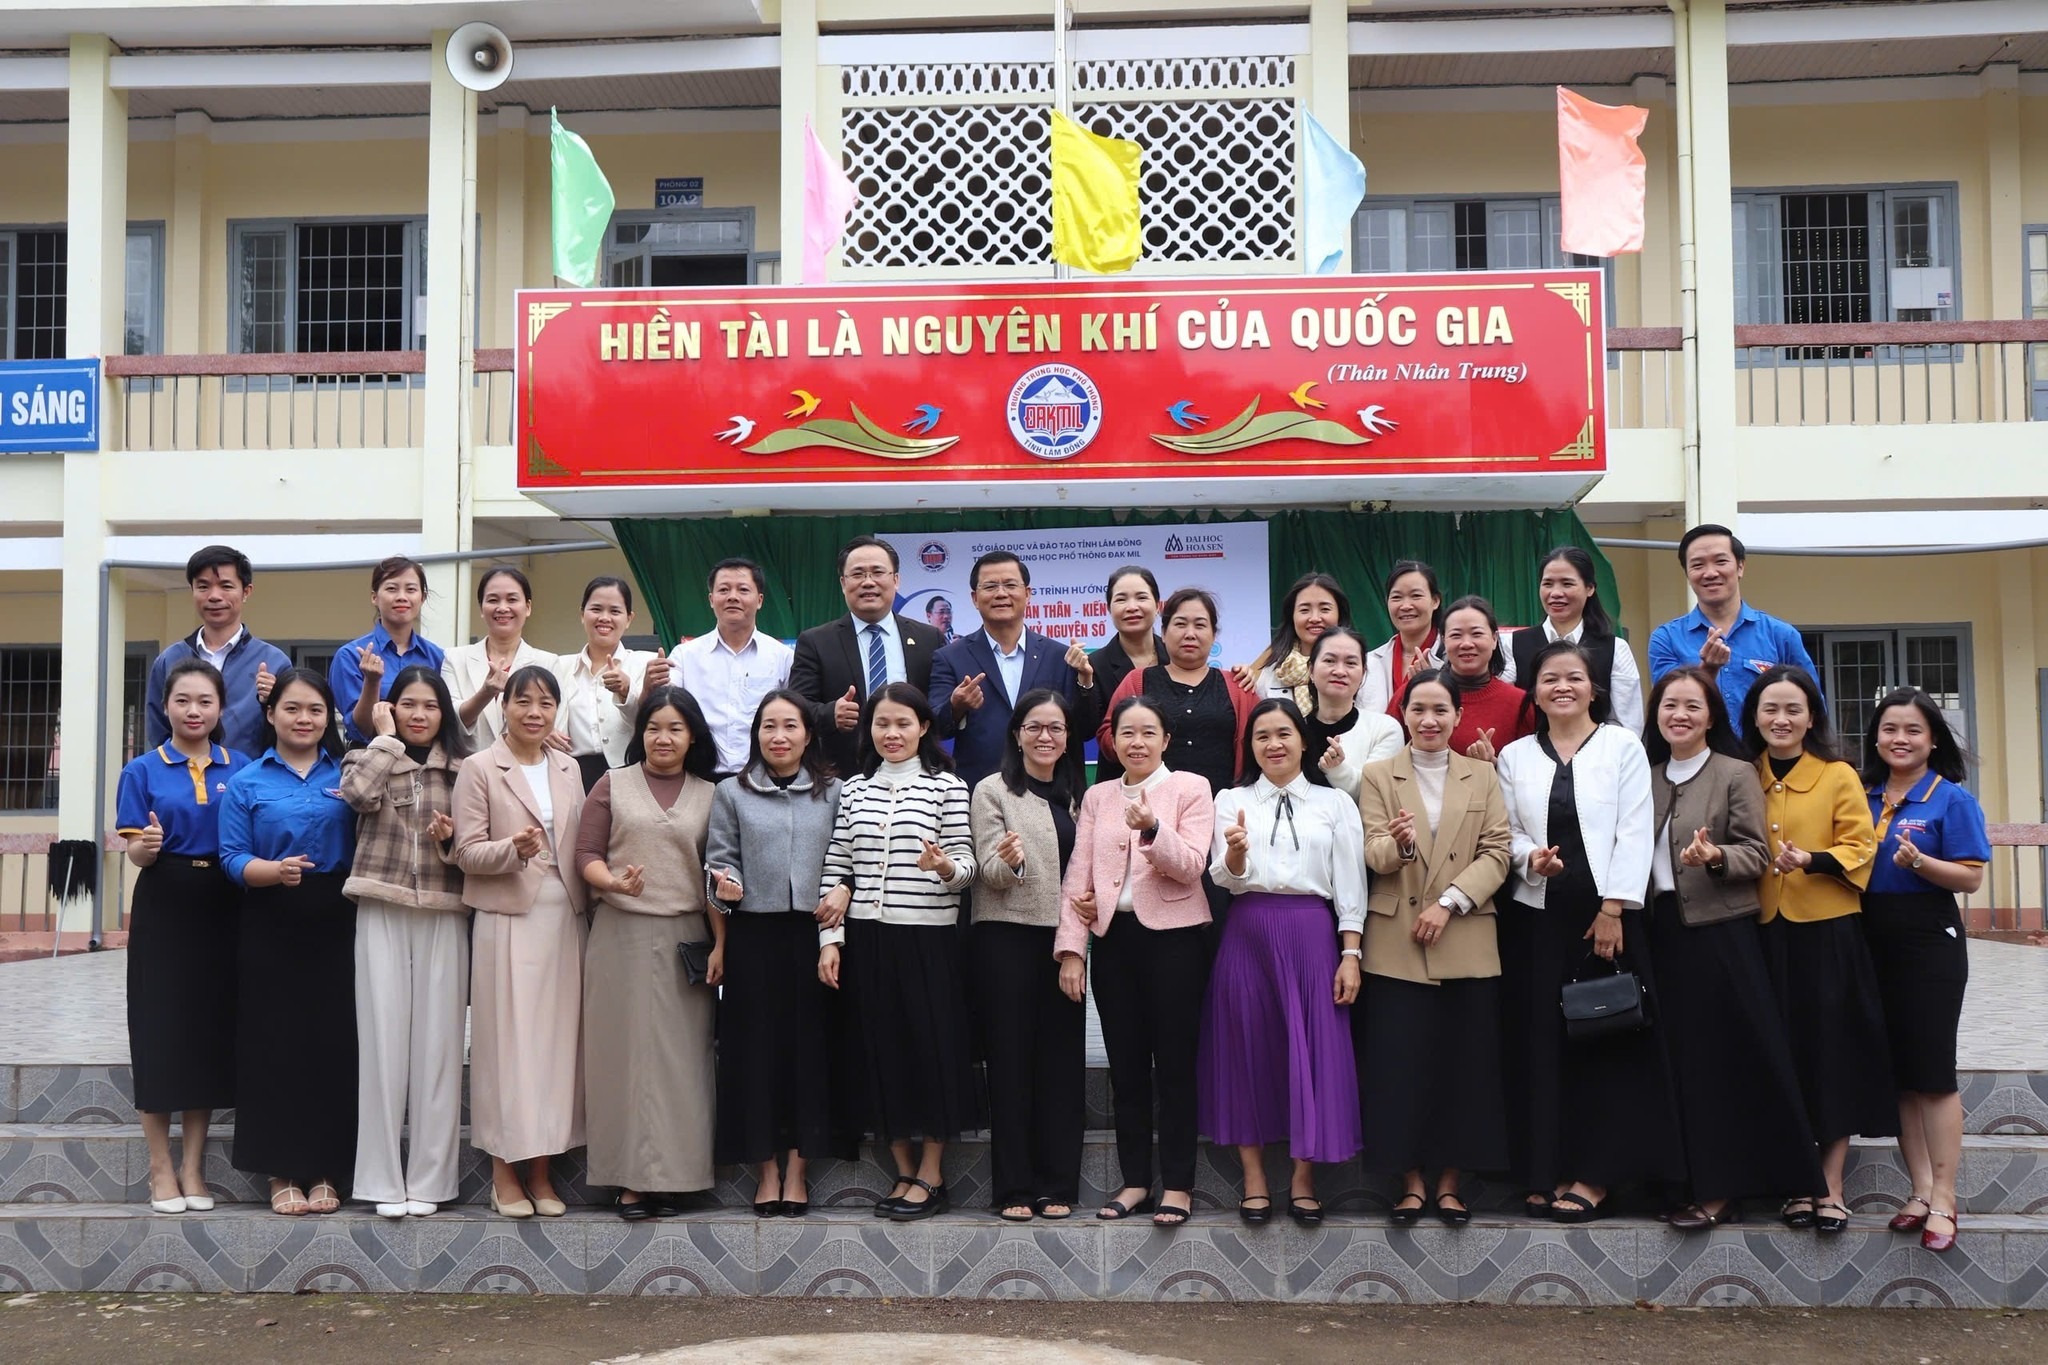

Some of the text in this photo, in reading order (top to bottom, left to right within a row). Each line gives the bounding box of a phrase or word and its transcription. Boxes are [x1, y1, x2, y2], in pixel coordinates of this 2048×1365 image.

[660, 194, 698, 206] 10A2
[600, 293, 1514, 361] HIỀN TÀI LÀ NGUYÊN KHÍ CỦA QUỐC GIA
[1327, 361, 1528, 385] (Thân Nhân Trung)
[1026, 367, 1052, 382] TRUNG
[1086, 385, 1098, 411] THÔNG
[12, 384, 86, 426] SÁNG
[984, 543, 1006, 552] GIÁO
[1007, 544, 1024, 552] DỤC
[1026, 542, 1038, 550] VÀ
[1040, 541, 1058, 550] ĐÀO
[1059, 542, 1076, 550] TẠO
[1078, 539, 1098, 548] TỈNH
[1098, 539, 1116, 548] LÂM
[1118, 538, 1142, 546] ĐỒNG
[1039, 554, 1058, 562] HỌC
[1059, 551, 1076, 560] PHỔ
[1078, 550, 1106, 559] THÔNG
[1040, 585, 1069, 596] TRÌNH
[1043, 601, 1071, 618] THÂN
[1082, 600, 1107, 617] KIẾN
[1046, 620, 1088, 638] NGUYÊN
[1092, 620, 1106, 637] SỐ
